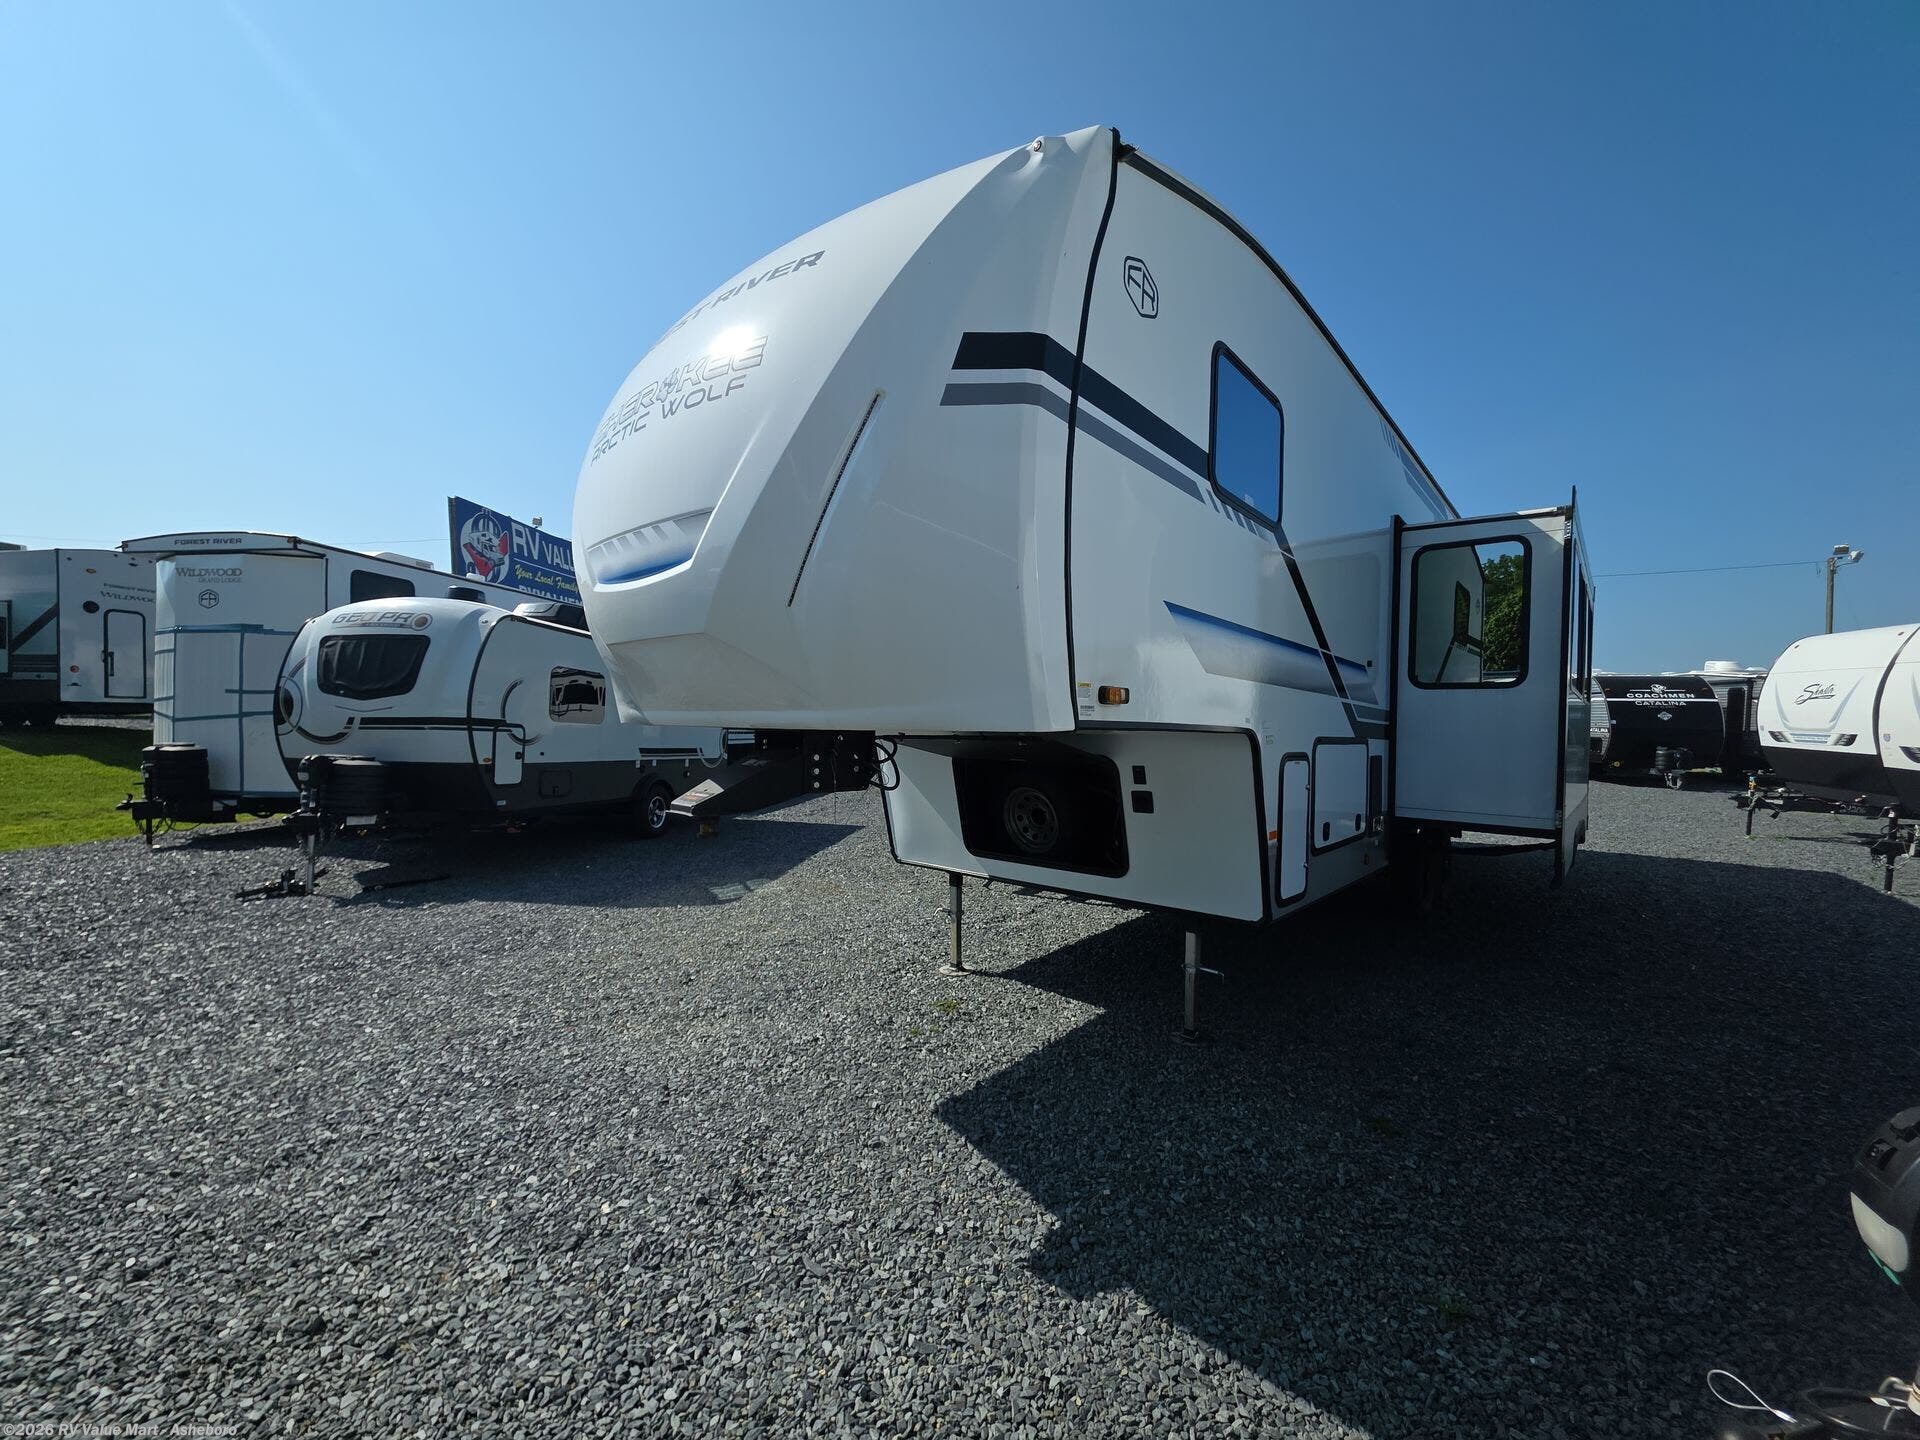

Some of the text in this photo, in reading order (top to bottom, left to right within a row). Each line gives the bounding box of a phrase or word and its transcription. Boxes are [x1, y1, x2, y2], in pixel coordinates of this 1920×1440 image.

[710, 249, 826, 309] RIVER
[590, 374, 747, 467] ARCTIC WOLF
[174, 537, 242, 546] FOREST RIVER
[510, 520, 542, 561] RV
[175, 567, 243, 577] WILDWOOD
[514, 564, 534, 581] Your
[534, 570, 555, 586] Local
